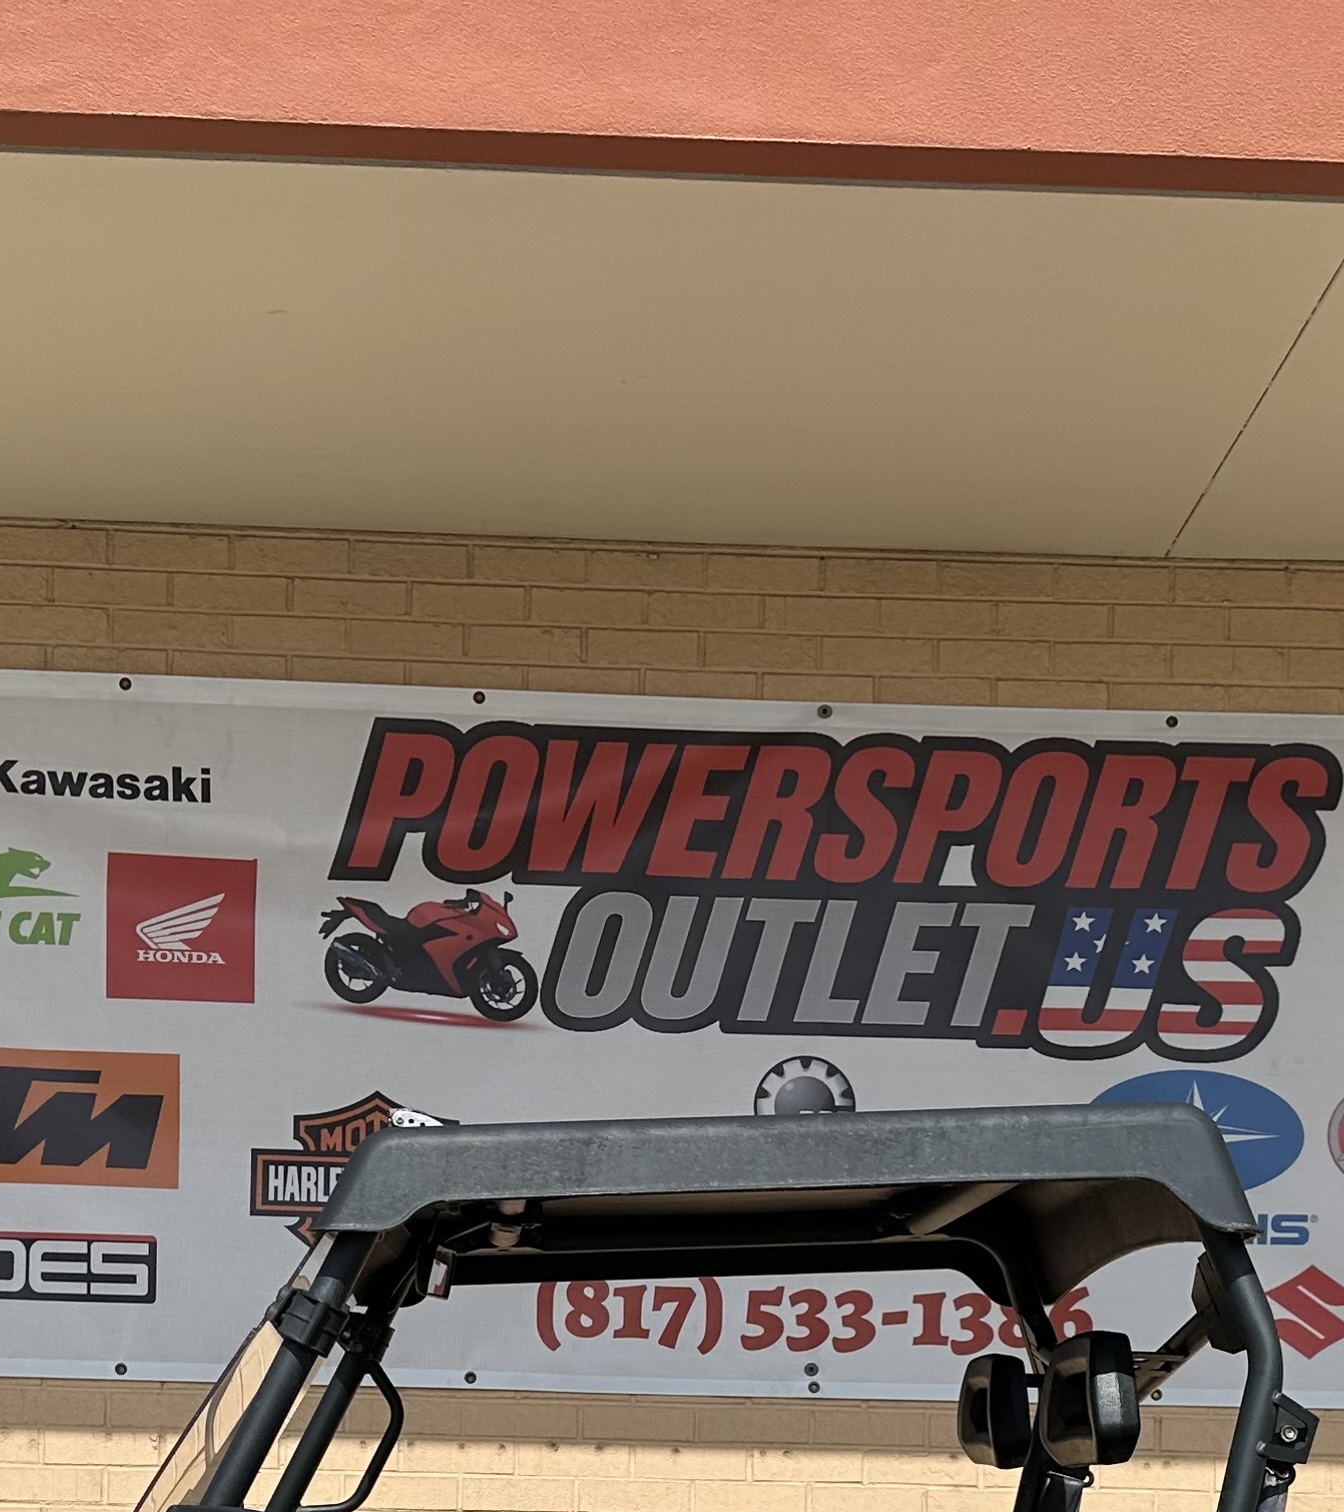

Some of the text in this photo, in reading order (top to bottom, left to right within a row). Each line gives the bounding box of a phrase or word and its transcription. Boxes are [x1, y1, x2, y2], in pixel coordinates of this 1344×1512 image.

[334, 722, 1338, 898] POWERSPORTS
[8, 909, 82, 946] CAT
[136, 949, 226, 965] HONDA
[320, 1110, 388, 1152] MOT
[268, 1164, 345, 1202] HARLE
[536, 1277, 723, 1354] (817)
